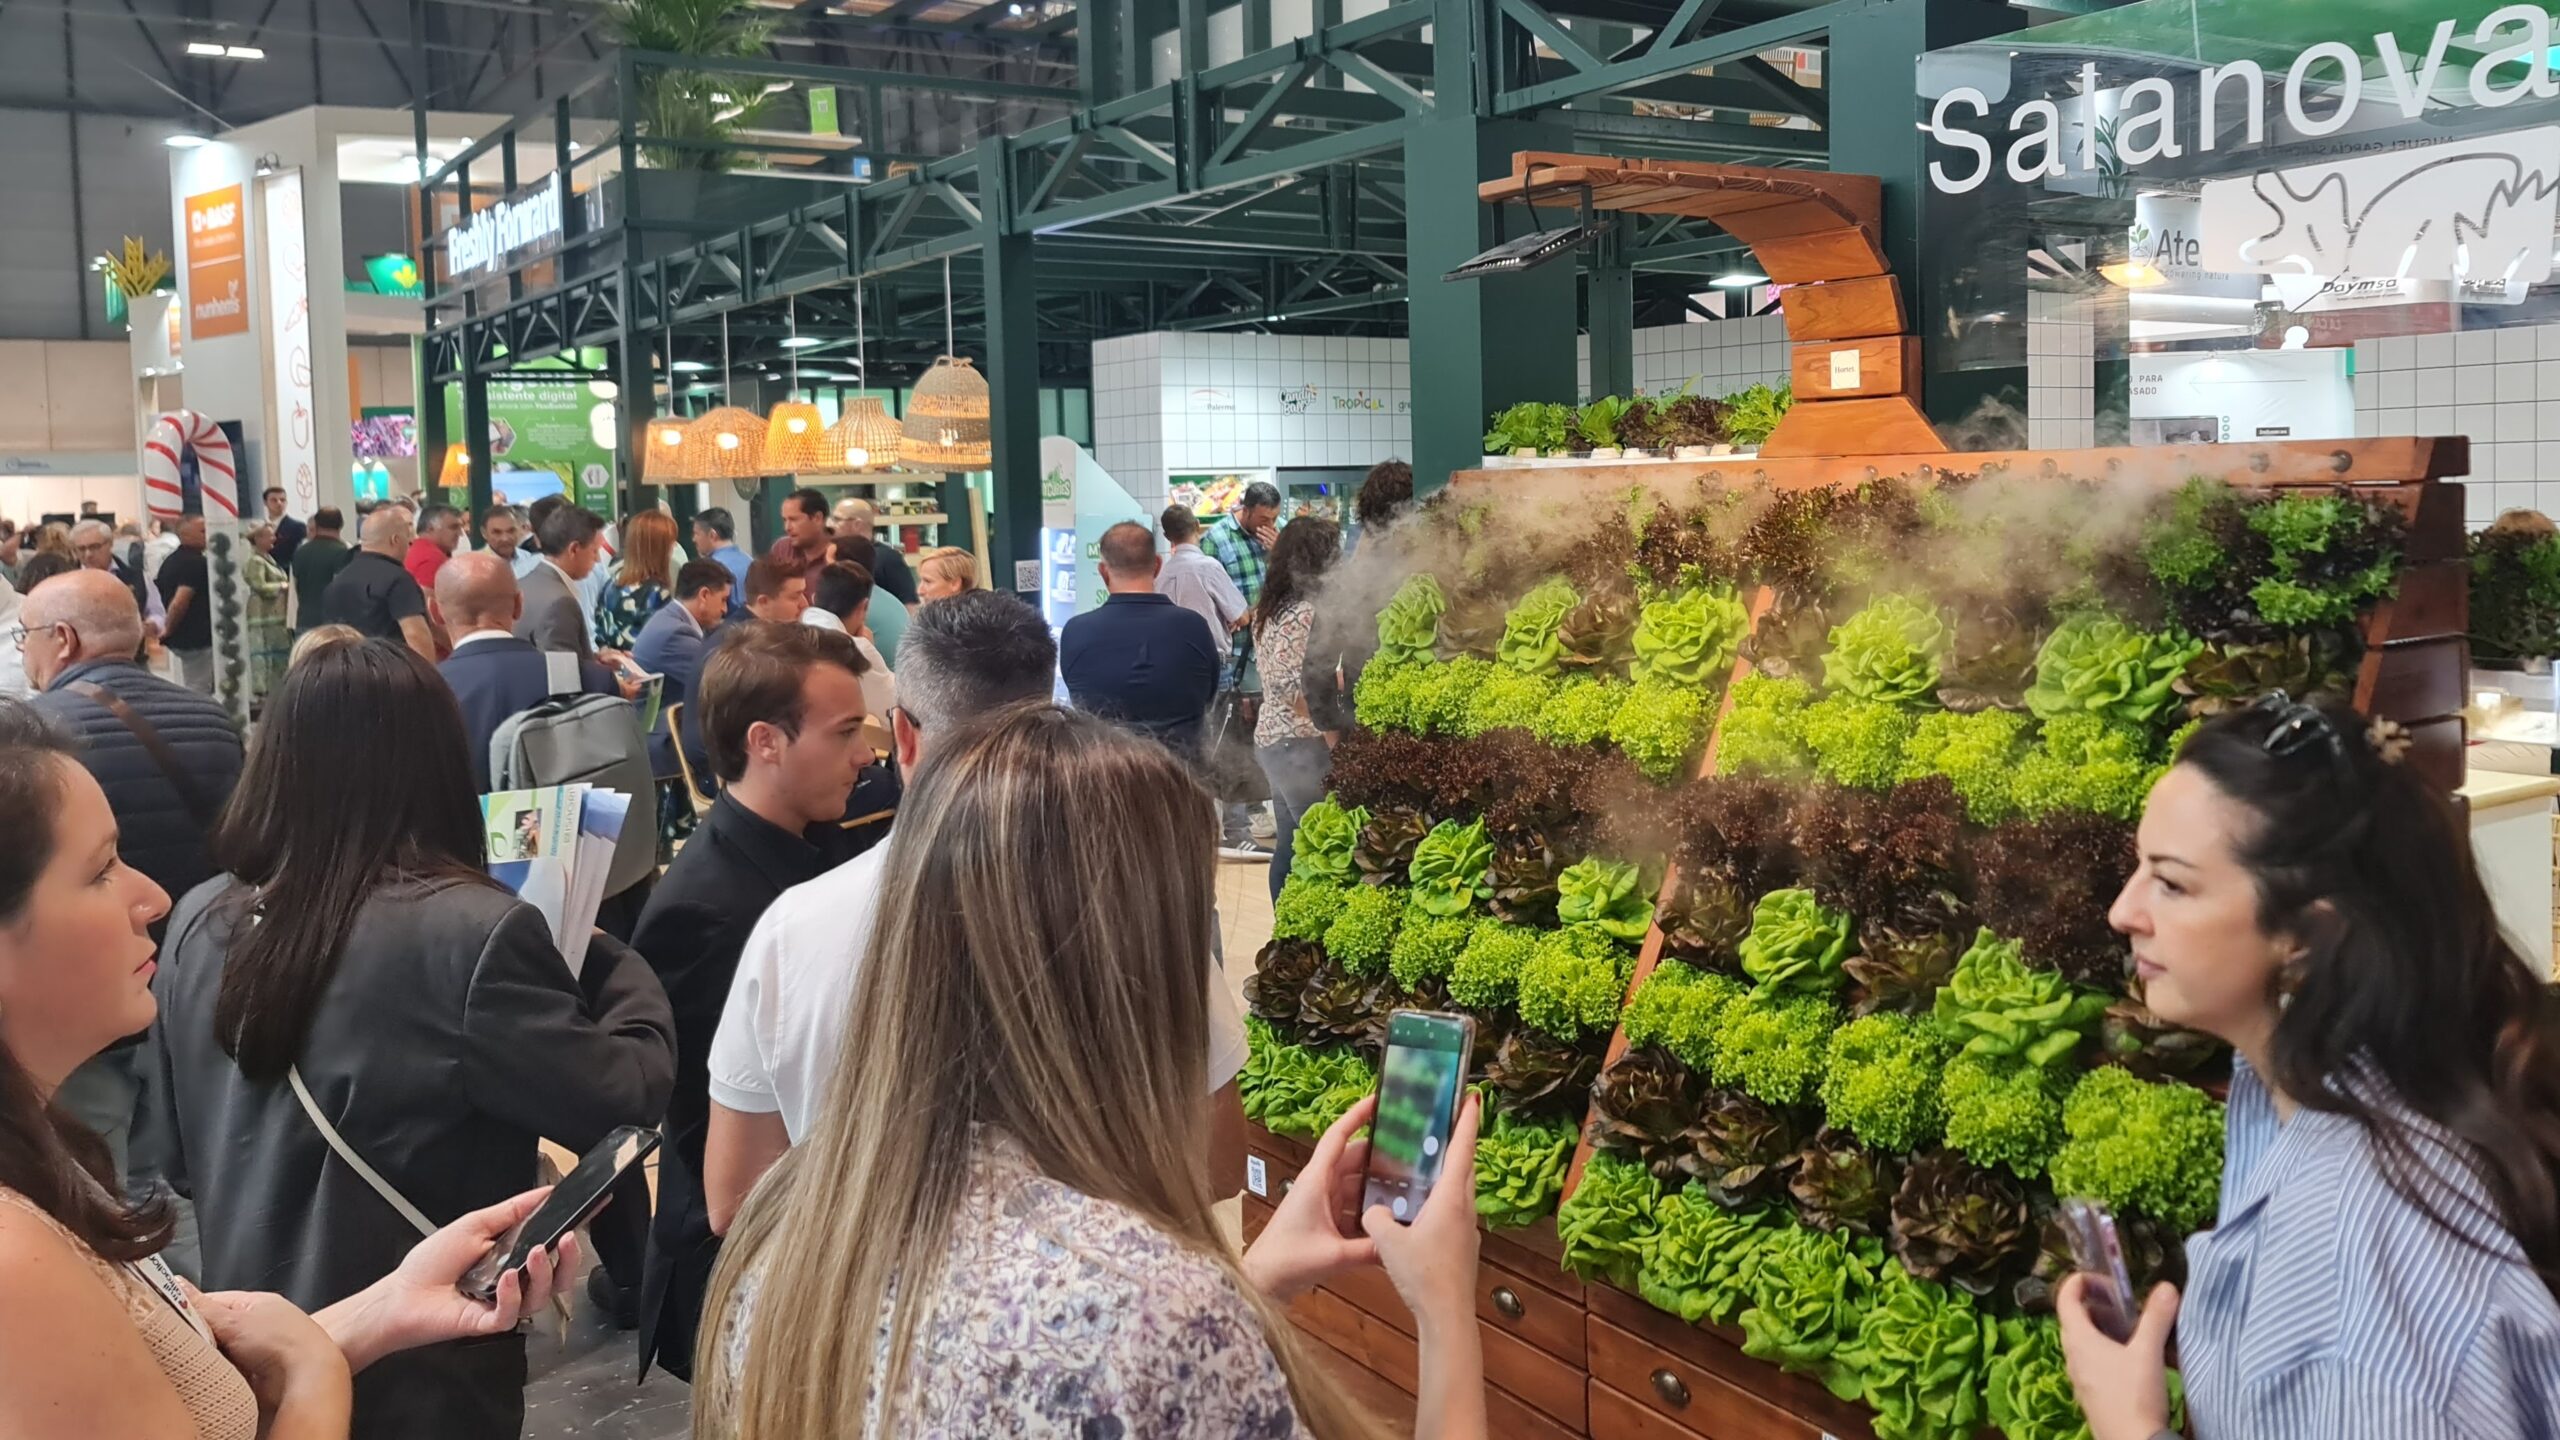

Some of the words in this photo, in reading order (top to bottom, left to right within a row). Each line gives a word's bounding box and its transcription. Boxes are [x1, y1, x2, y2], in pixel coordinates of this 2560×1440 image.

[1929, 3, 2560, 195] Salanova
[2156, 228, 2200, 267] Ate
[2139, 374, 2163, 384] PARA
[539, 390, 577, 403] digital
